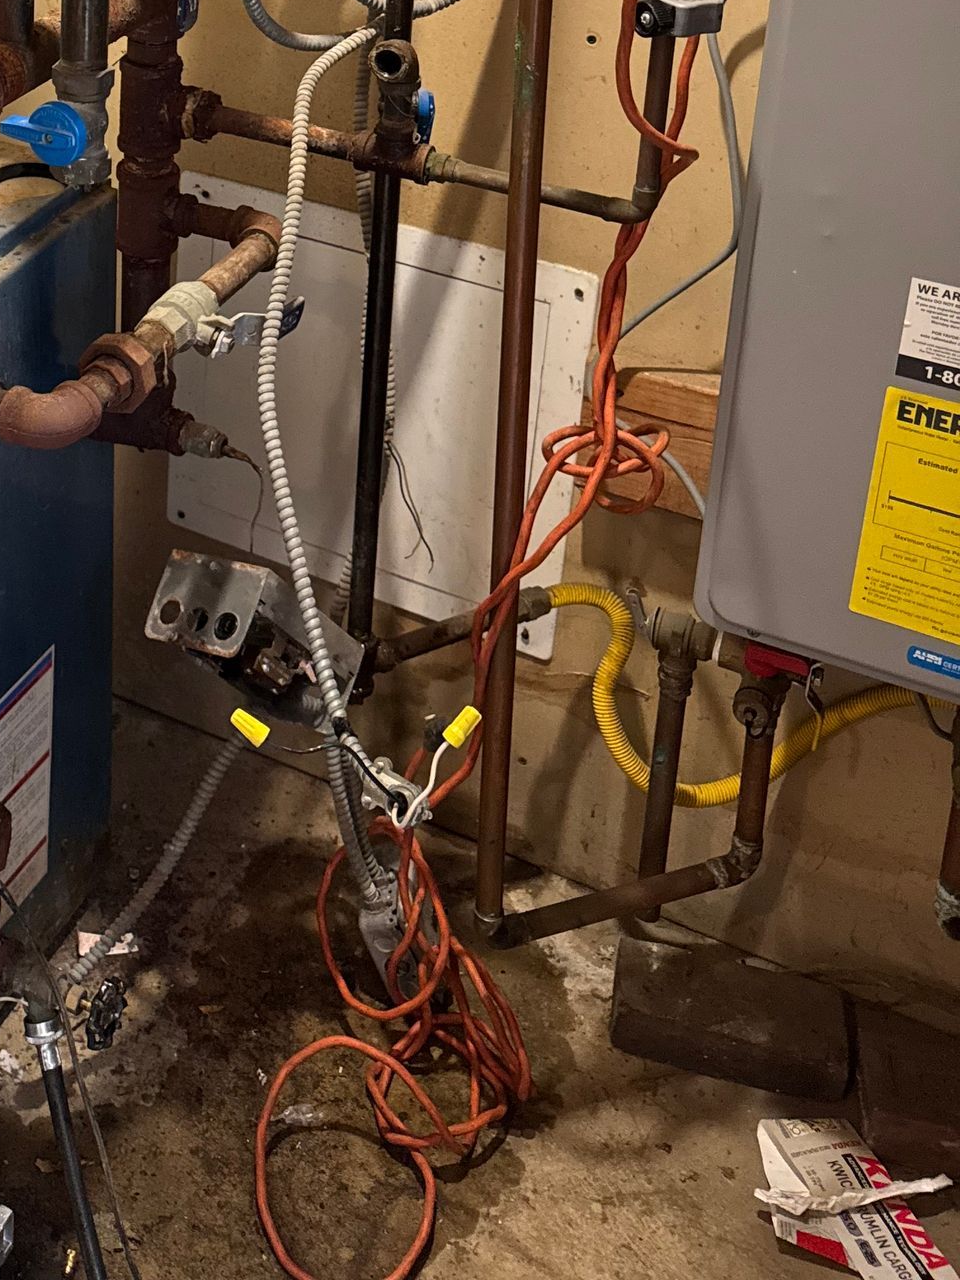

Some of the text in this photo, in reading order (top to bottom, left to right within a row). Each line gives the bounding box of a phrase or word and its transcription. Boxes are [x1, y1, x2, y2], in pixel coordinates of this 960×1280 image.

[917, 284, 939, 296] WE
[918, 458, 958, 473] Estimated
[827, 1159, 855, 1191] KWIC
[855, 1204, 892, 1250] RUMLIN
